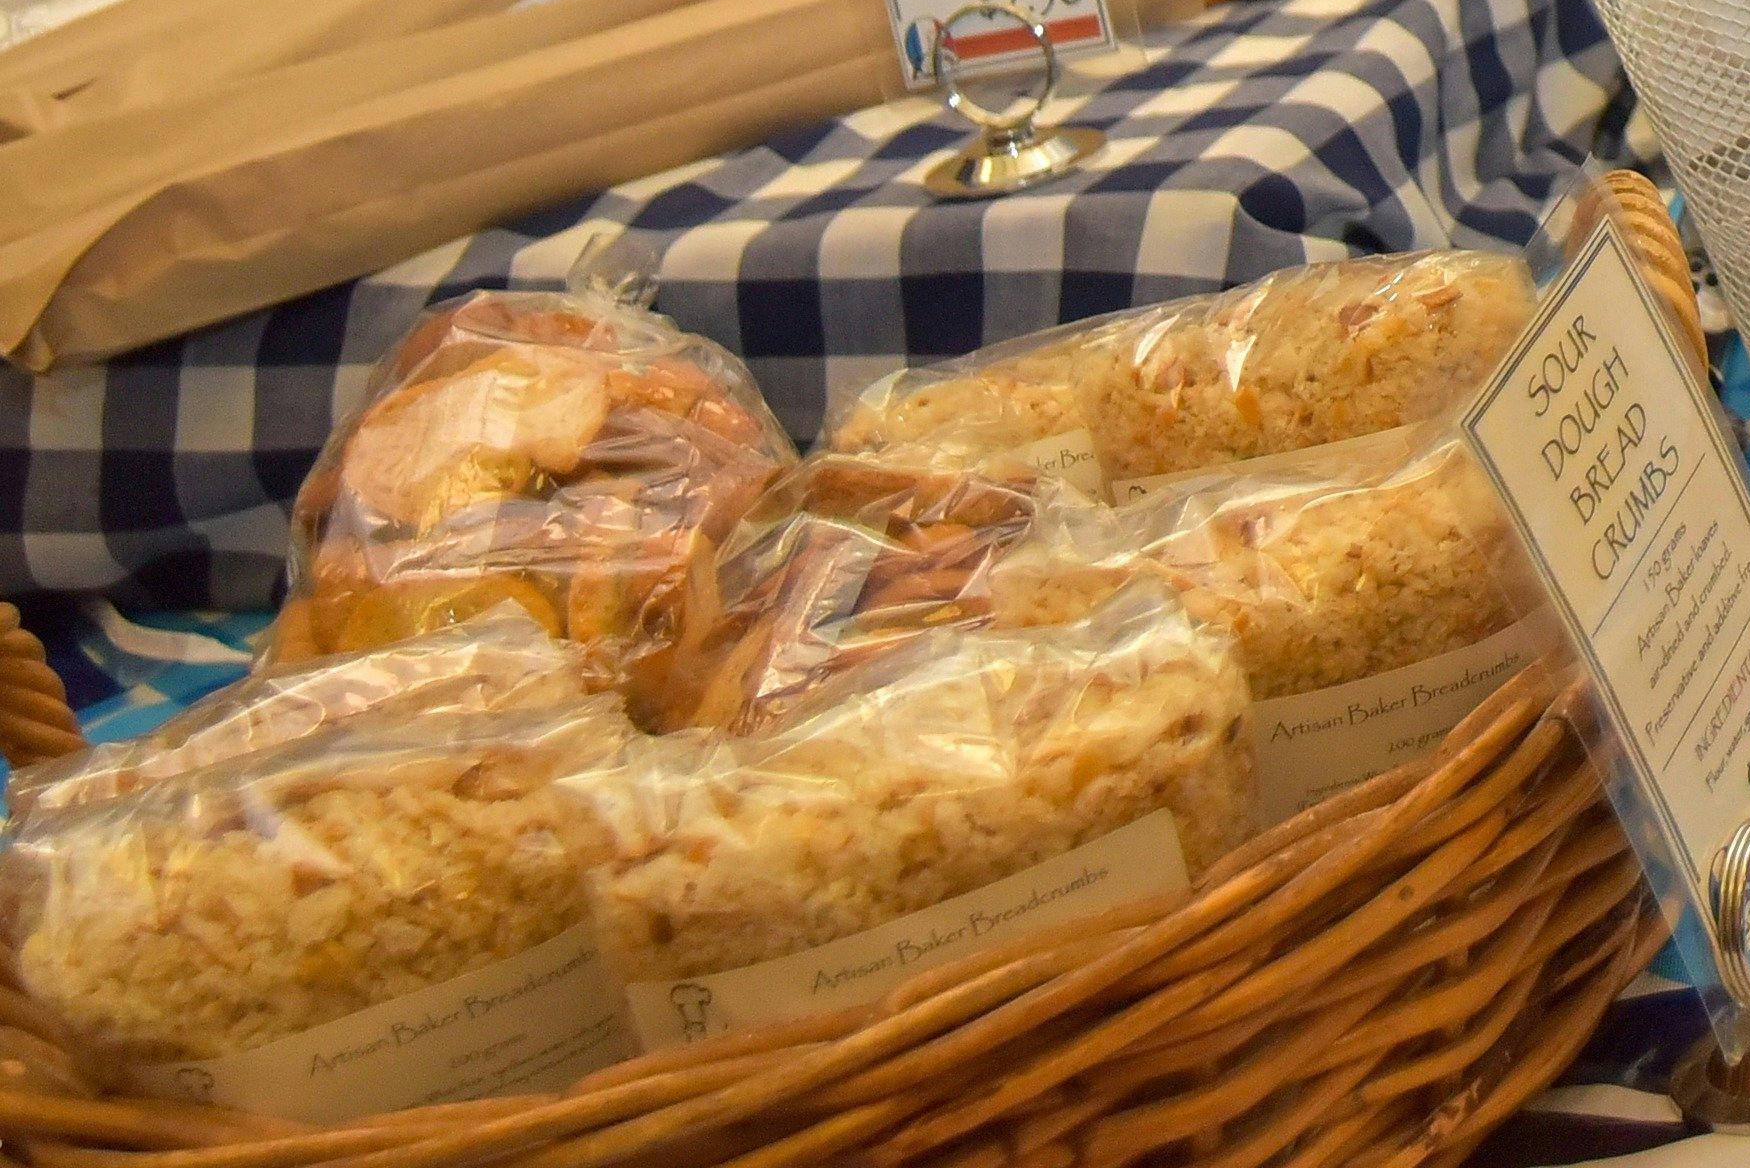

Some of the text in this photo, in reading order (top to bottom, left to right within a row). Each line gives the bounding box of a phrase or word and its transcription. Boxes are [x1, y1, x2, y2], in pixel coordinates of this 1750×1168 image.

[1528, 314, 1597, 417] SOUR
[1541, 346, 1629, 481] DOUGH
[1569, 402, 1647, 526] BREAD
[1591, 435, 1680, 580] CRUMBS
[1637, 519, 1720, 662] Artisan Baker loaves
[1642, 521, 1687, 592] 150 grams
[1683, 593, 1700, 632] and
[1270, 651, 1522, 744] Artisan Baker Breadcrumbs
[1644, 659, 1699, 748] Preservative
[1697, 623, 1715, 663] and
[1712, 582, 1743, 635] additive
[811, 866, 1109, 995] Artisan Baker Breadcrumbs
[390, 1008, 462, 1044] Baker
